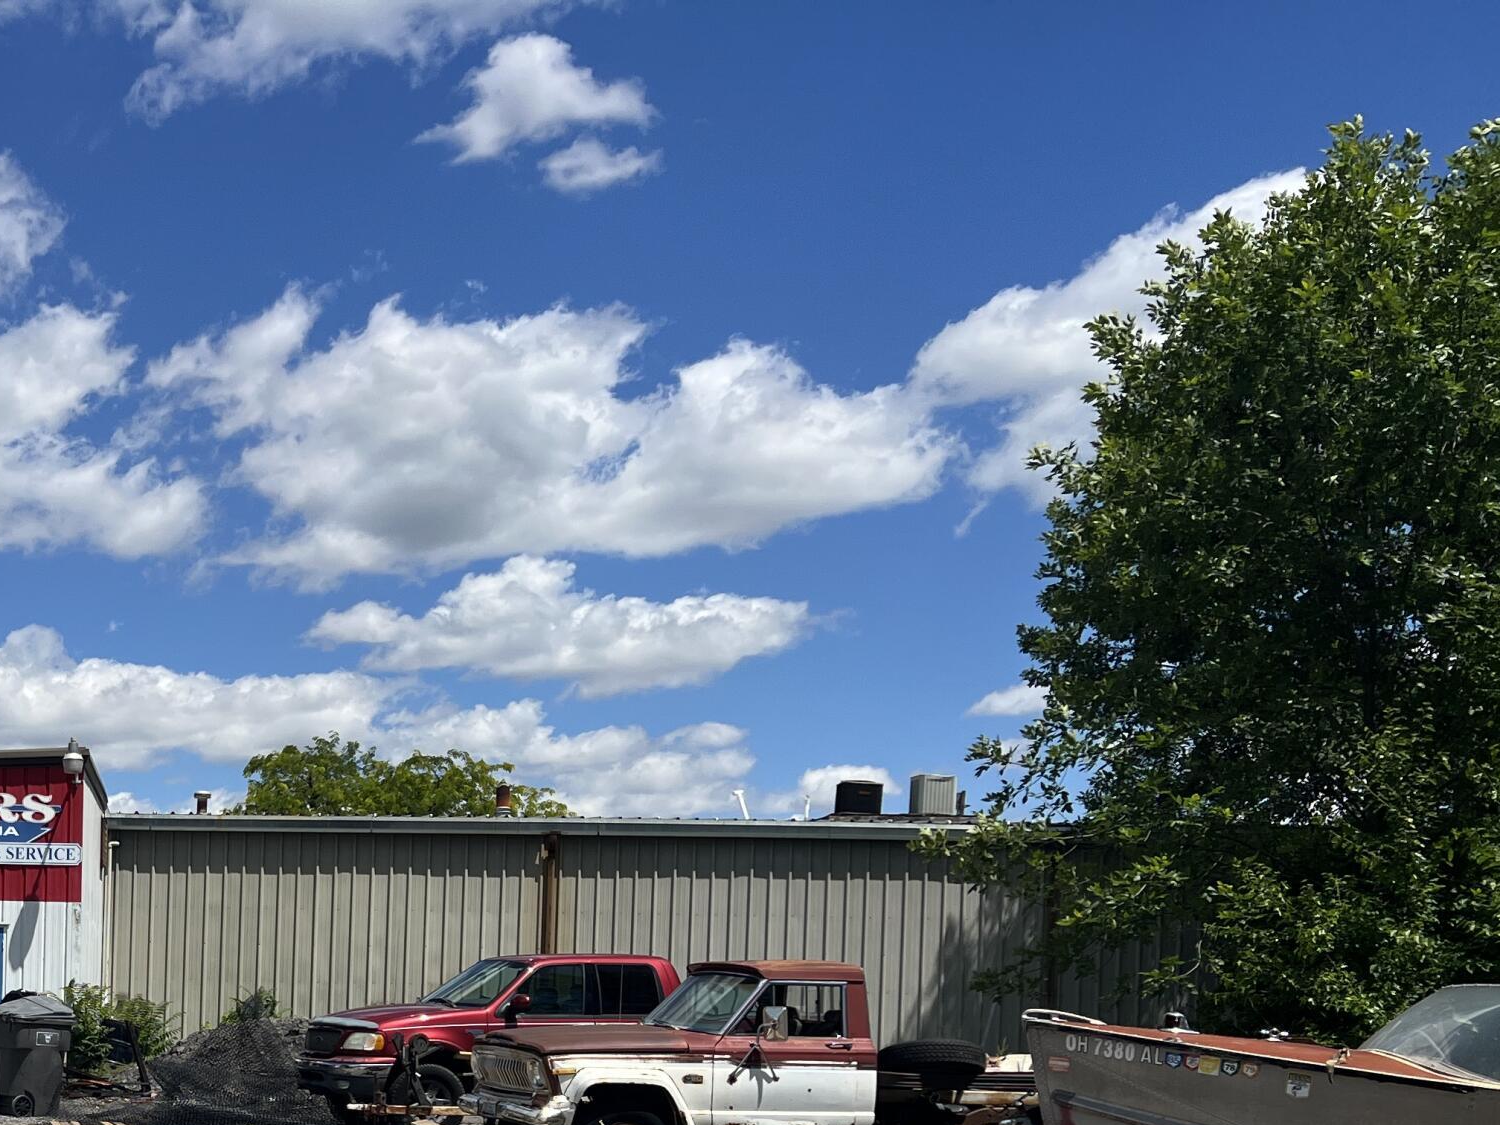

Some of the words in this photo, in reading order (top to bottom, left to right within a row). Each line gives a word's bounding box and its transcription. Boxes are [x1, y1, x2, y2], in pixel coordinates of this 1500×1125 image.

[5, 848, 77, 861] SERVICE
[1065, 1034, 1088, 1053] OH
[1094, 1038, 1136, 1062] 7380
